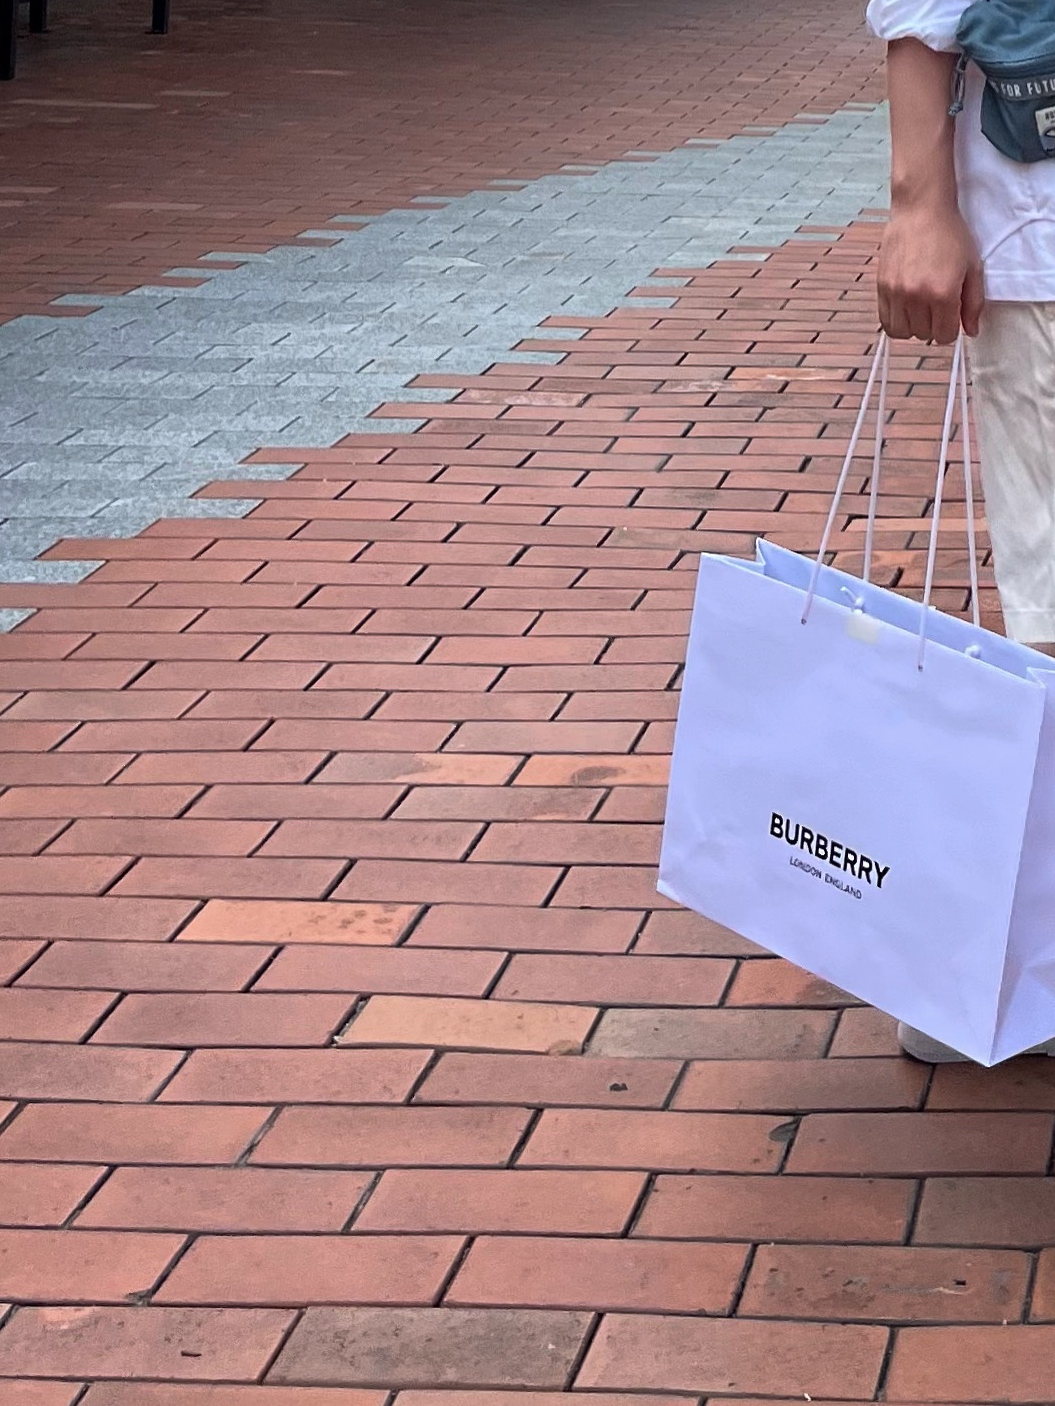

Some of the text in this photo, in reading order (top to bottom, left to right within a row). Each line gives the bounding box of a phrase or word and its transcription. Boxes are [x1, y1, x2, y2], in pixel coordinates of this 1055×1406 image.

[1000, 81, 1022, 97] FOR
[769, 811, 891, 889] BURBERRY
[789, 855, 862, 900] LONDON ENGLAND
